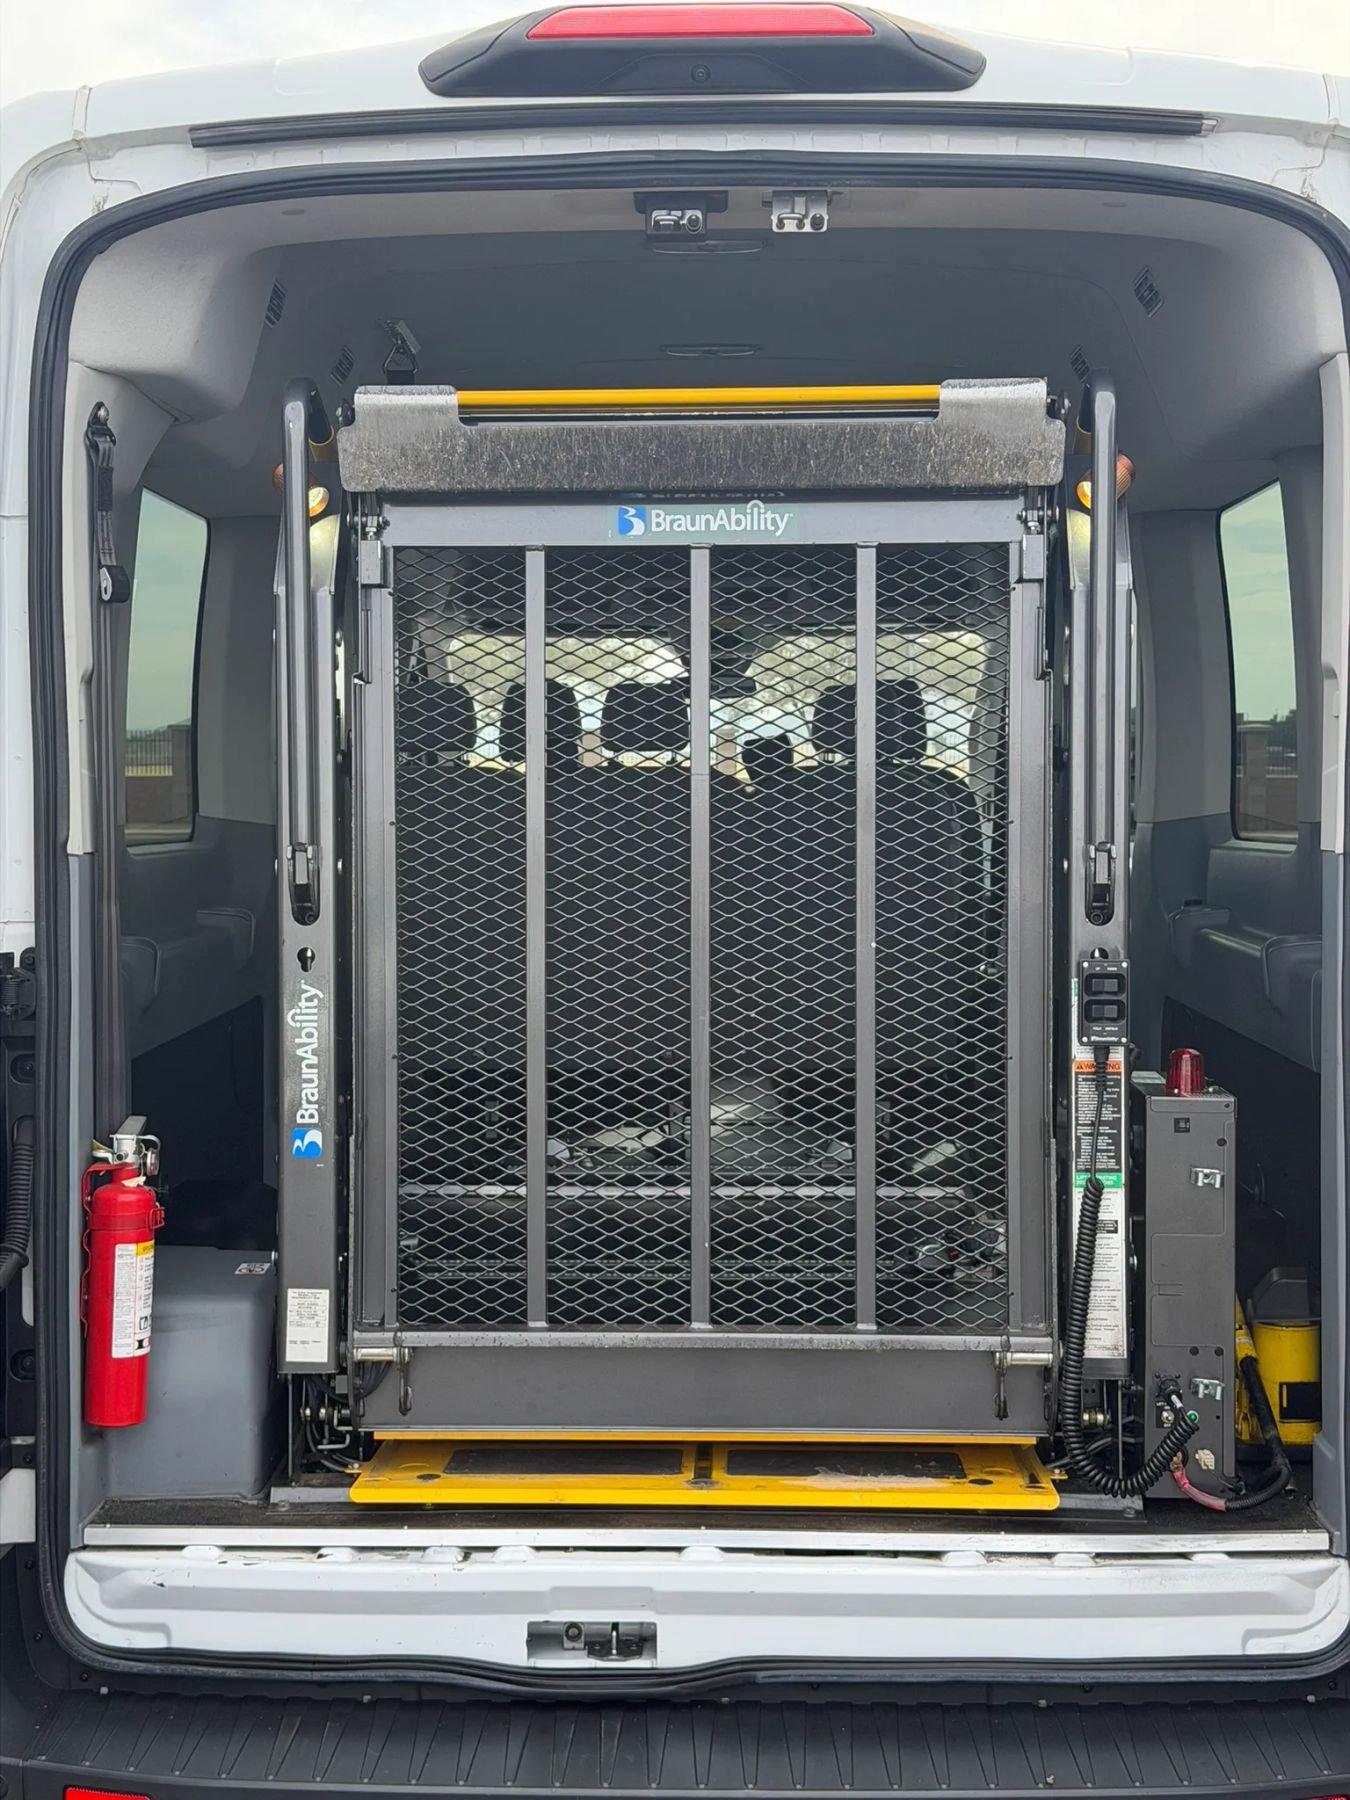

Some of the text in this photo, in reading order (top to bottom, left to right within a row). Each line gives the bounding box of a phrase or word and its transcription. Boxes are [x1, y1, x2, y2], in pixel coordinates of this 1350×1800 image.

[651, 500, 790, 537] BraunAbility
[287, 982, 324, 1124] BraunAbility
[1083, 1061, 1121, 1071] WANG
